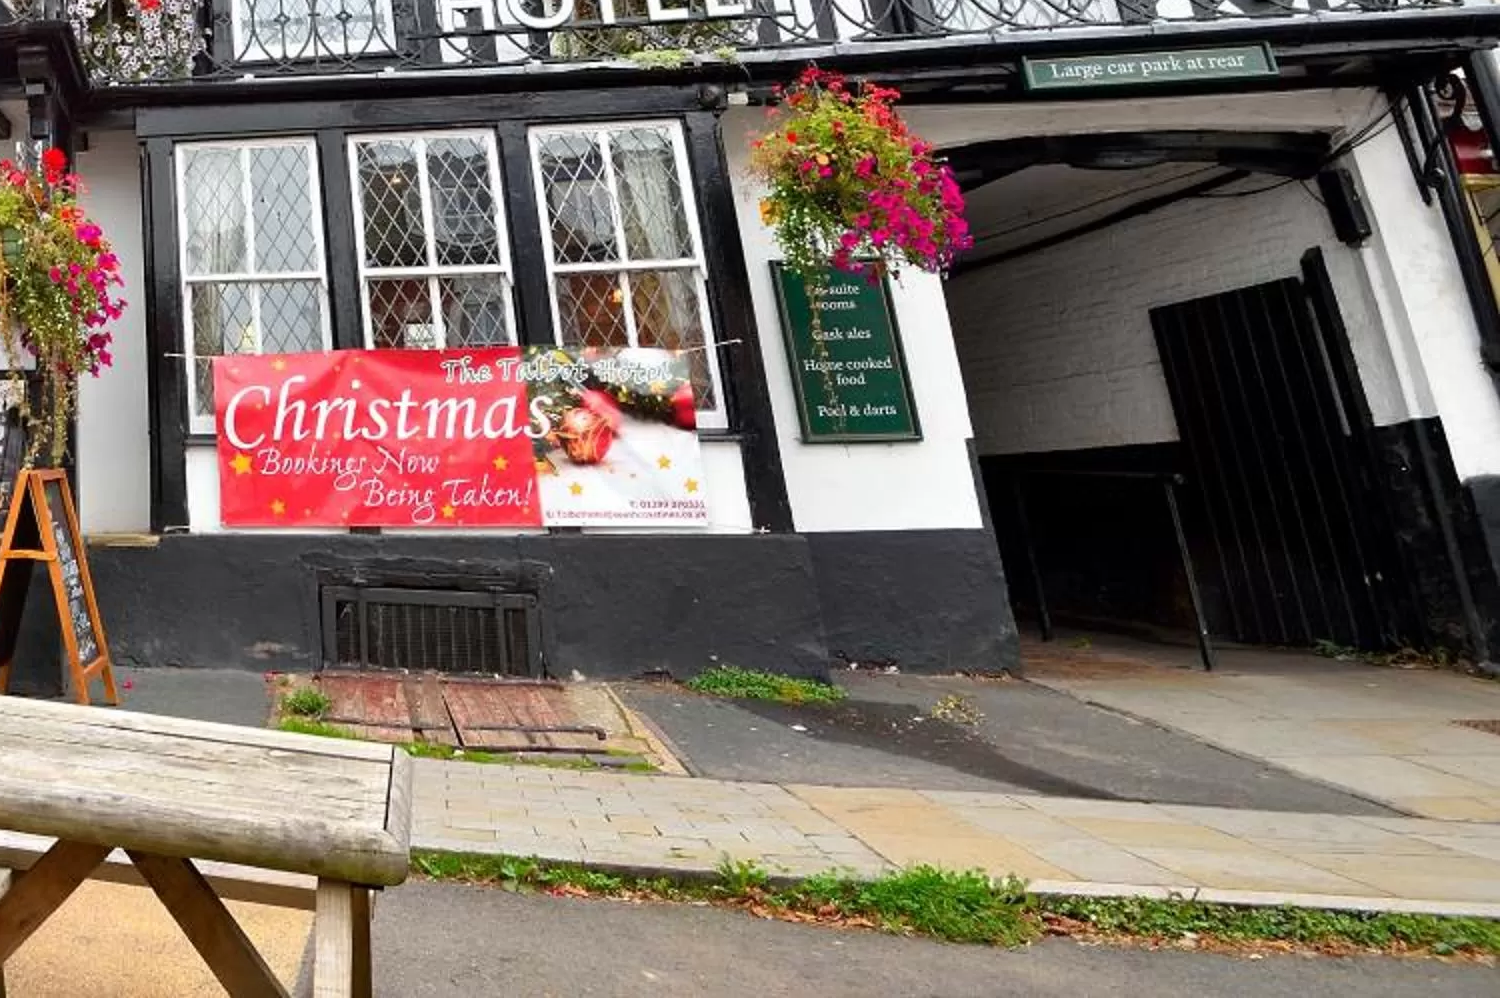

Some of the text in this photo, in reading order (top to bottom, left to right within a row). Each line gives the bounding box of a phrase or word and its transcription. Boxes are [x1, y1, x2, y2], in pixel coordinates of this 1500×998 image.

[1050, 54, 1246, 80] Large car park at rear
[847, 326, 872, 340] ales
[441, 356, 493, 384] The
[496, 352, 588, 384] Talbot
[846, 356, 893, 370] cooked
[836, 372, 866, 386] food
[223, 375, 555, 449] Christmas
[849, 404, 861, 417] &
[863, 403, 897, 417] darts
[255, 445, 440, 490] Bookings Now
[360, 477, 532, 523] Being Taken!
